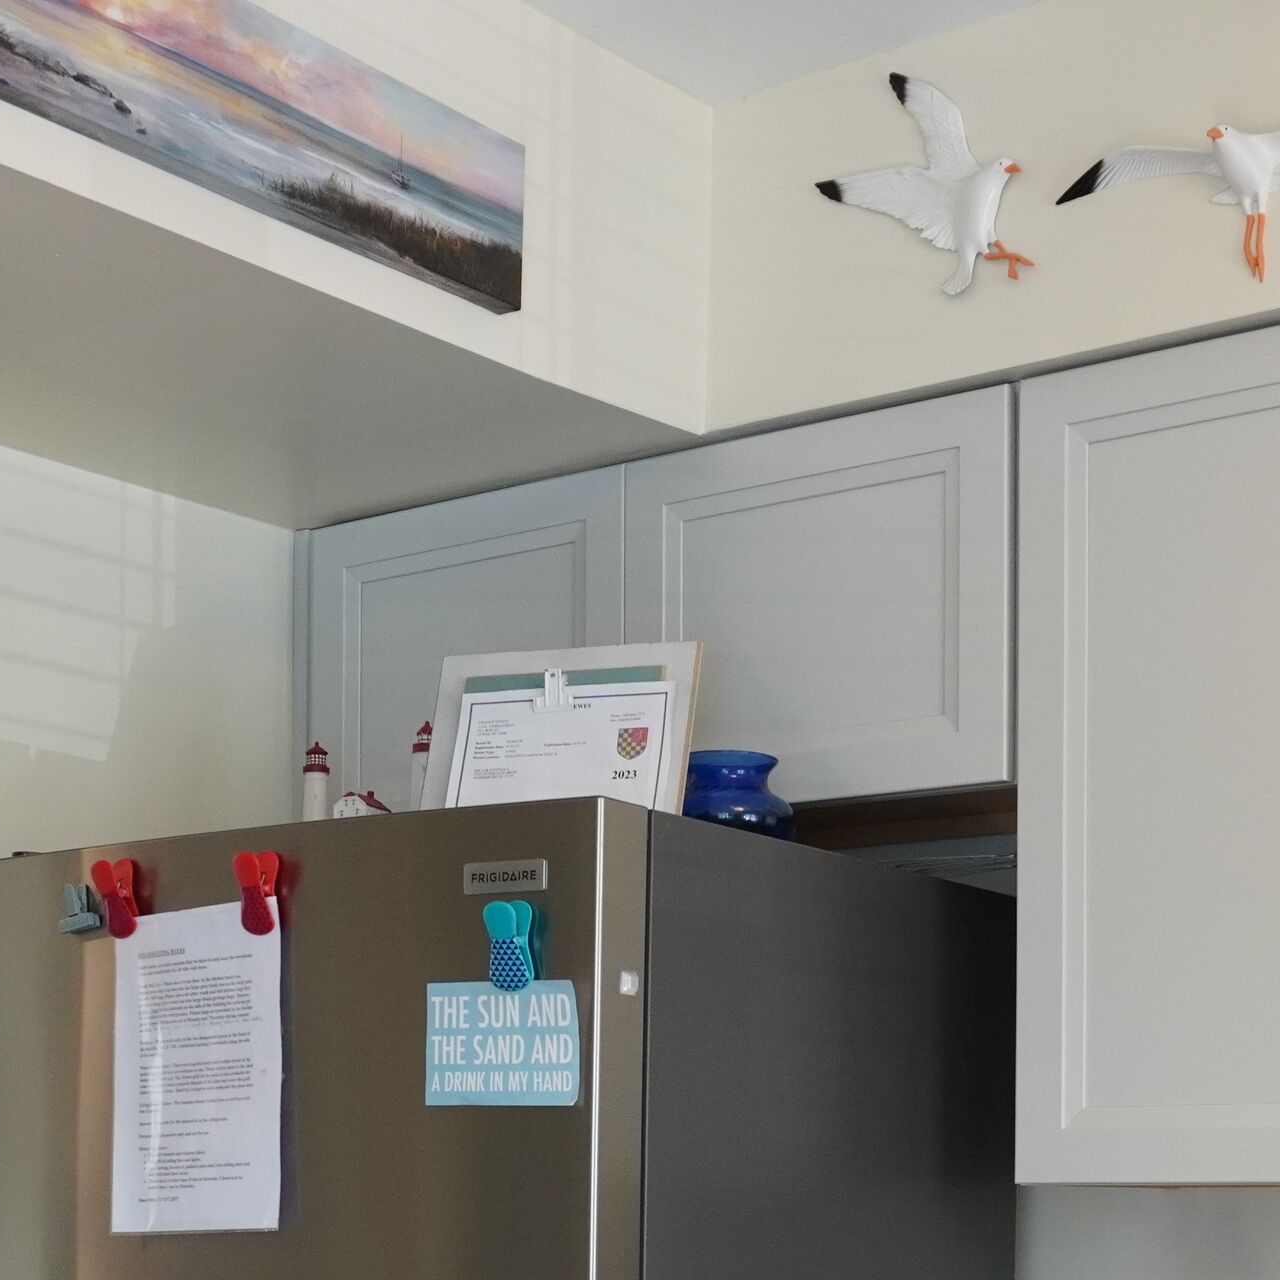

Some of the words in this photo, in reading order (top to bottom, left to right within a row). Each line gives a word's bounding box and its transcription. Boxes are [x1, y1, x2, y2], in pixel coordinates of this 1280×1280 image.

[612, 770, 637, 780] 2023
[471, 869, 537, 884] FRIGIDAIRE
[431, 995, 469, 1029] THE
[478, 994, 520, 1029] SUN
[527, 994, 571, 1028] AND
[432, 1035, 466, 1065] THE
[473, 1034, 525, 1065] SAND
[531, 1033, 573, 1064] AND
[431, 1072, 440, 1092] A
[444, 1071, 485, 1092] DRINK
[490, 1071, 502, 1092] IN
[508, 1071, 528, 1092] MY
[533, 1070, 572, 1092] HAND
